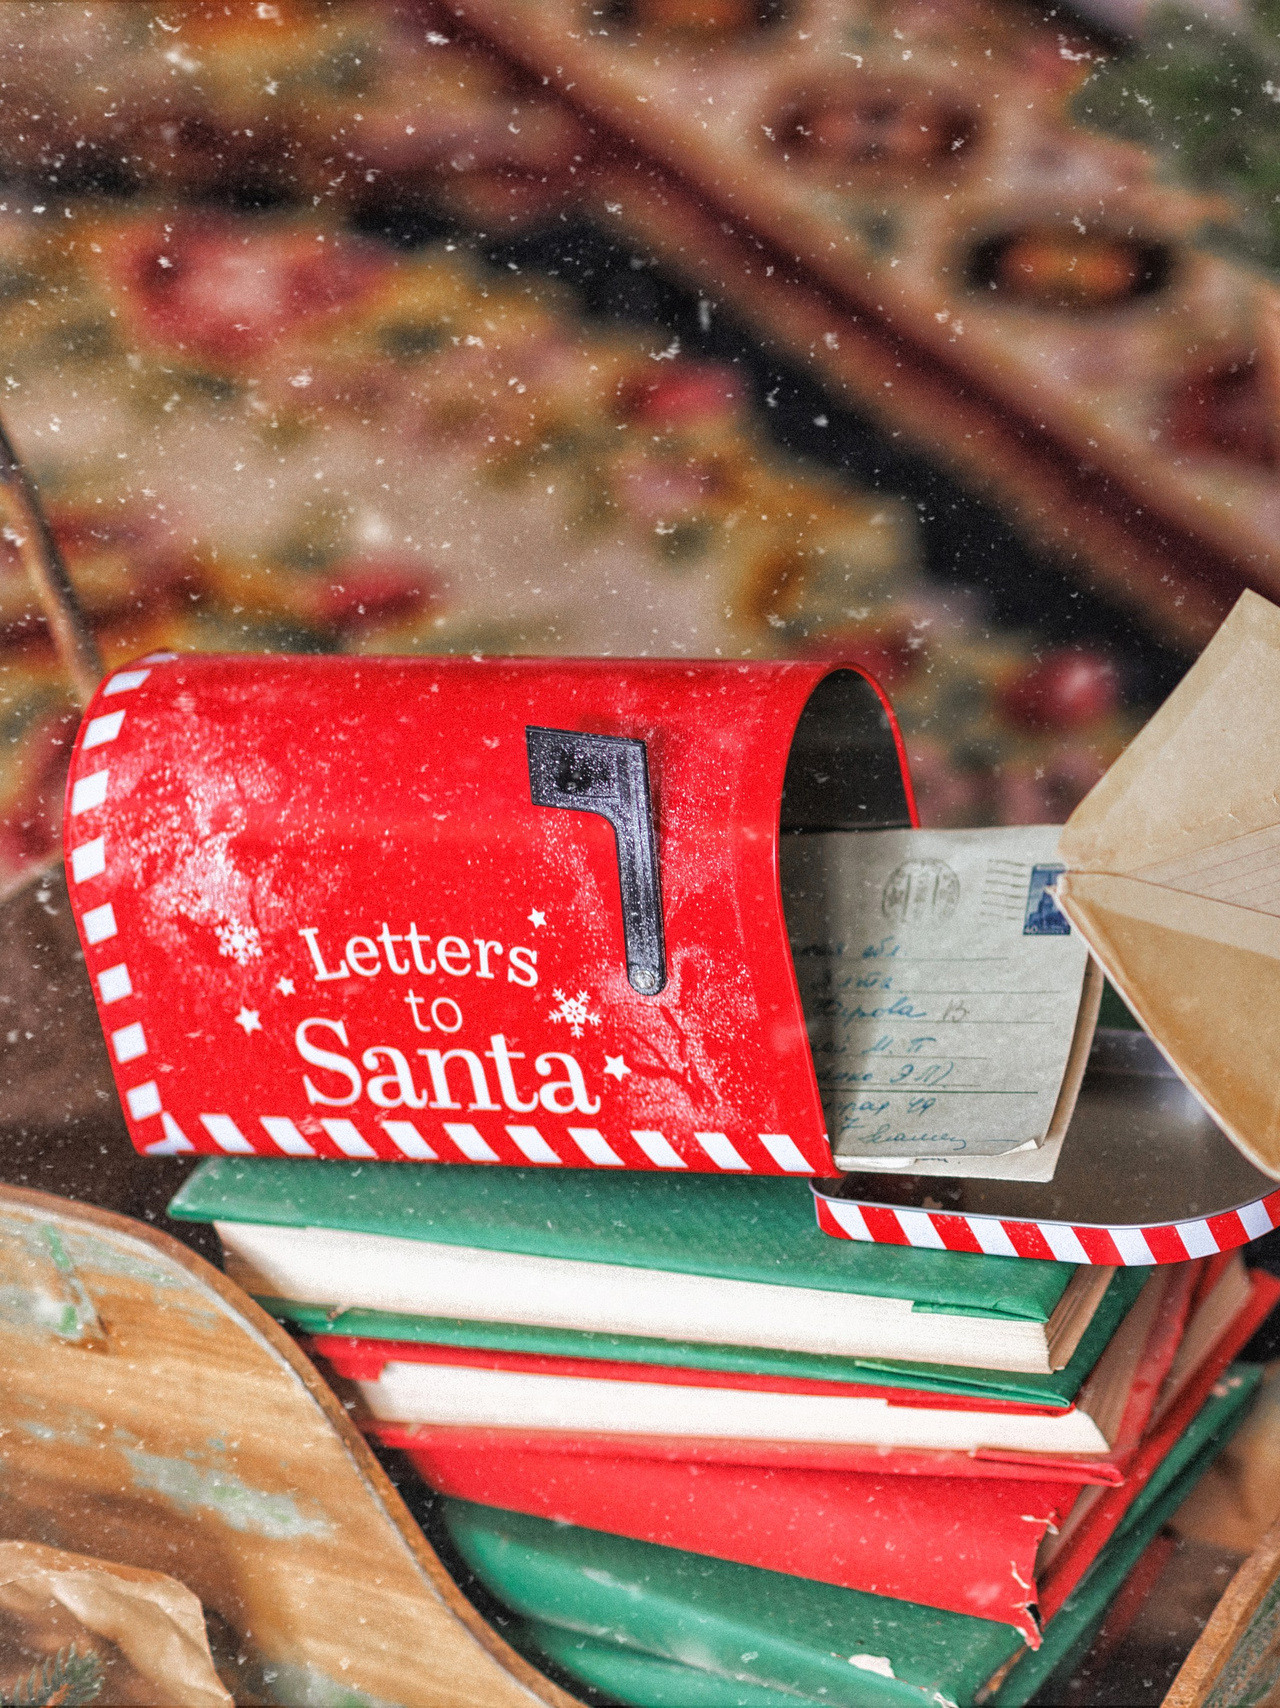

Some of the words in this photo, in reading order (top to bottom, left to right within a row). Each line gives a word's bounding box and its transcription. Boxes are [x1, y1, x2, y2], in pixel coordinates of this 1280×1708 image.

[298, 921, 539, 988] Letters
[403, 988, 463, 1033] to
[295, 1016, 601, 1115] Santa
